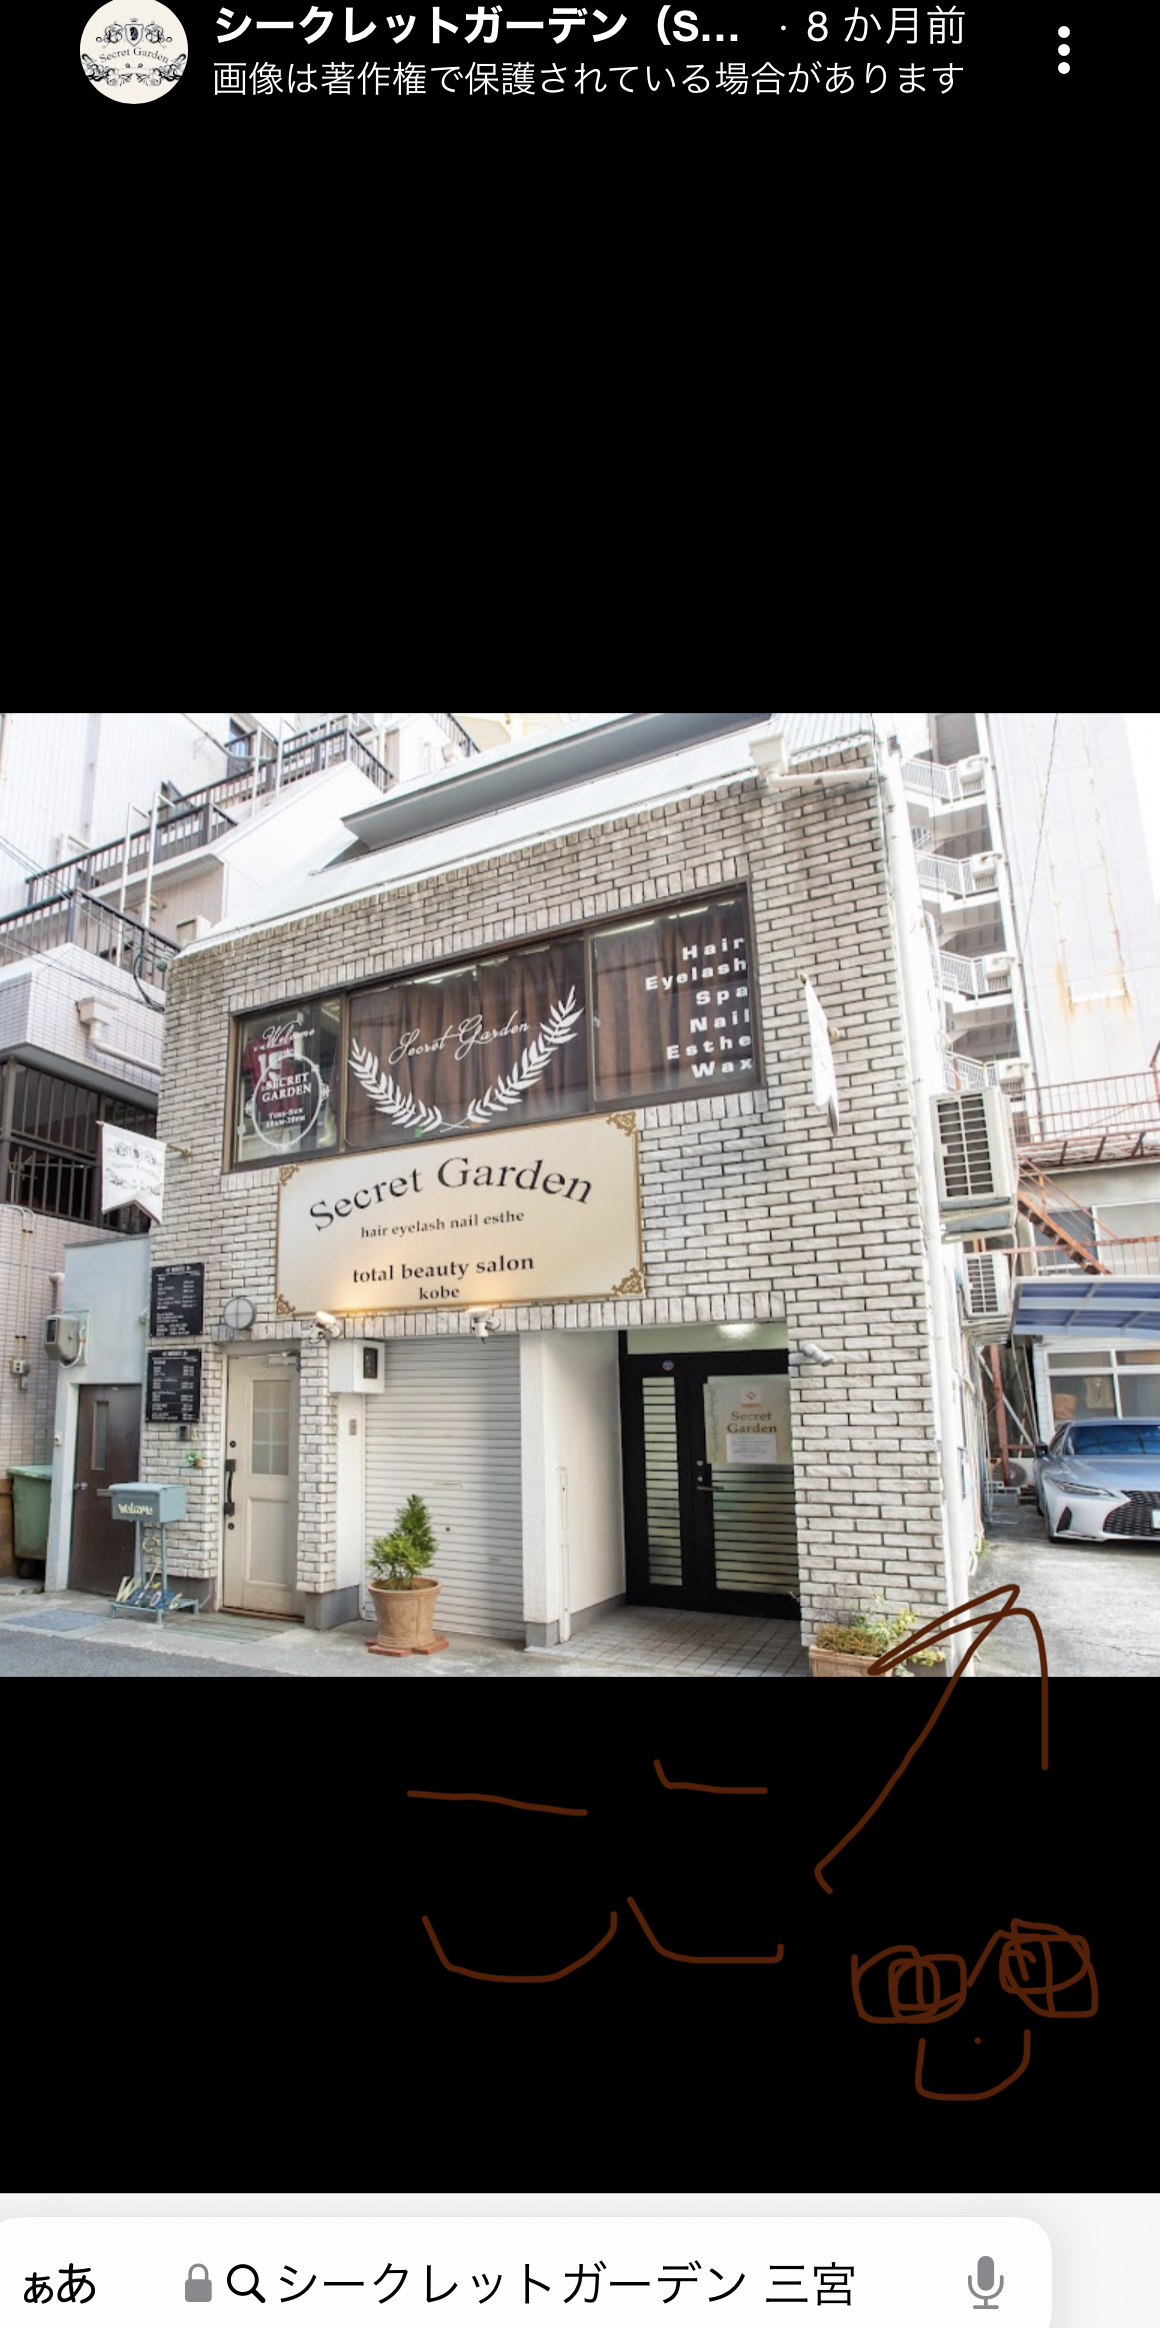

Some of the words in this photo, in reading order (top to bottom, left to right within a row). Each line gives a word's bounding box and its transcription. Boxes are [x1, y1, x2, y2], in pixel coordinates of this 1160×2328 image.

[682, 937, 745, 961] Hair
[645, 957, 747, 991] Eyelash
[695, 986, 748, 1005] Spa
[690, 1008, 750, 1033] Nail
[389, 1025, 459, 1065] Secret
[455, 1010, 530, 1061] Garden
[666, 1035, 752, 1060] Esthe
[691, 1057, 753, 1079] Wax
[262, 1083, 312, 1102] GARDEN
[264, 1072, 309, 1091] SECRET
[309, 1167, 424, 1231] Secret
[437, 1157, 593, 1204] Garden
[361, 1225, 388, 1238] hair
[391, 1218, 446, 1237] eyelash
[449, 1214, 479, 1229] nail
[483, 1210, 525, 1225] esthe
[352, 1265, 394, 1283] total
[401, 1261, 469, 1280] beauty
[475, 1255, 535, 1274] salon
[418, 1286, 460, 1301] kobe
[731, 1410, 772, 1421] Secret
[727, 1423, 777, 1433] Garden
